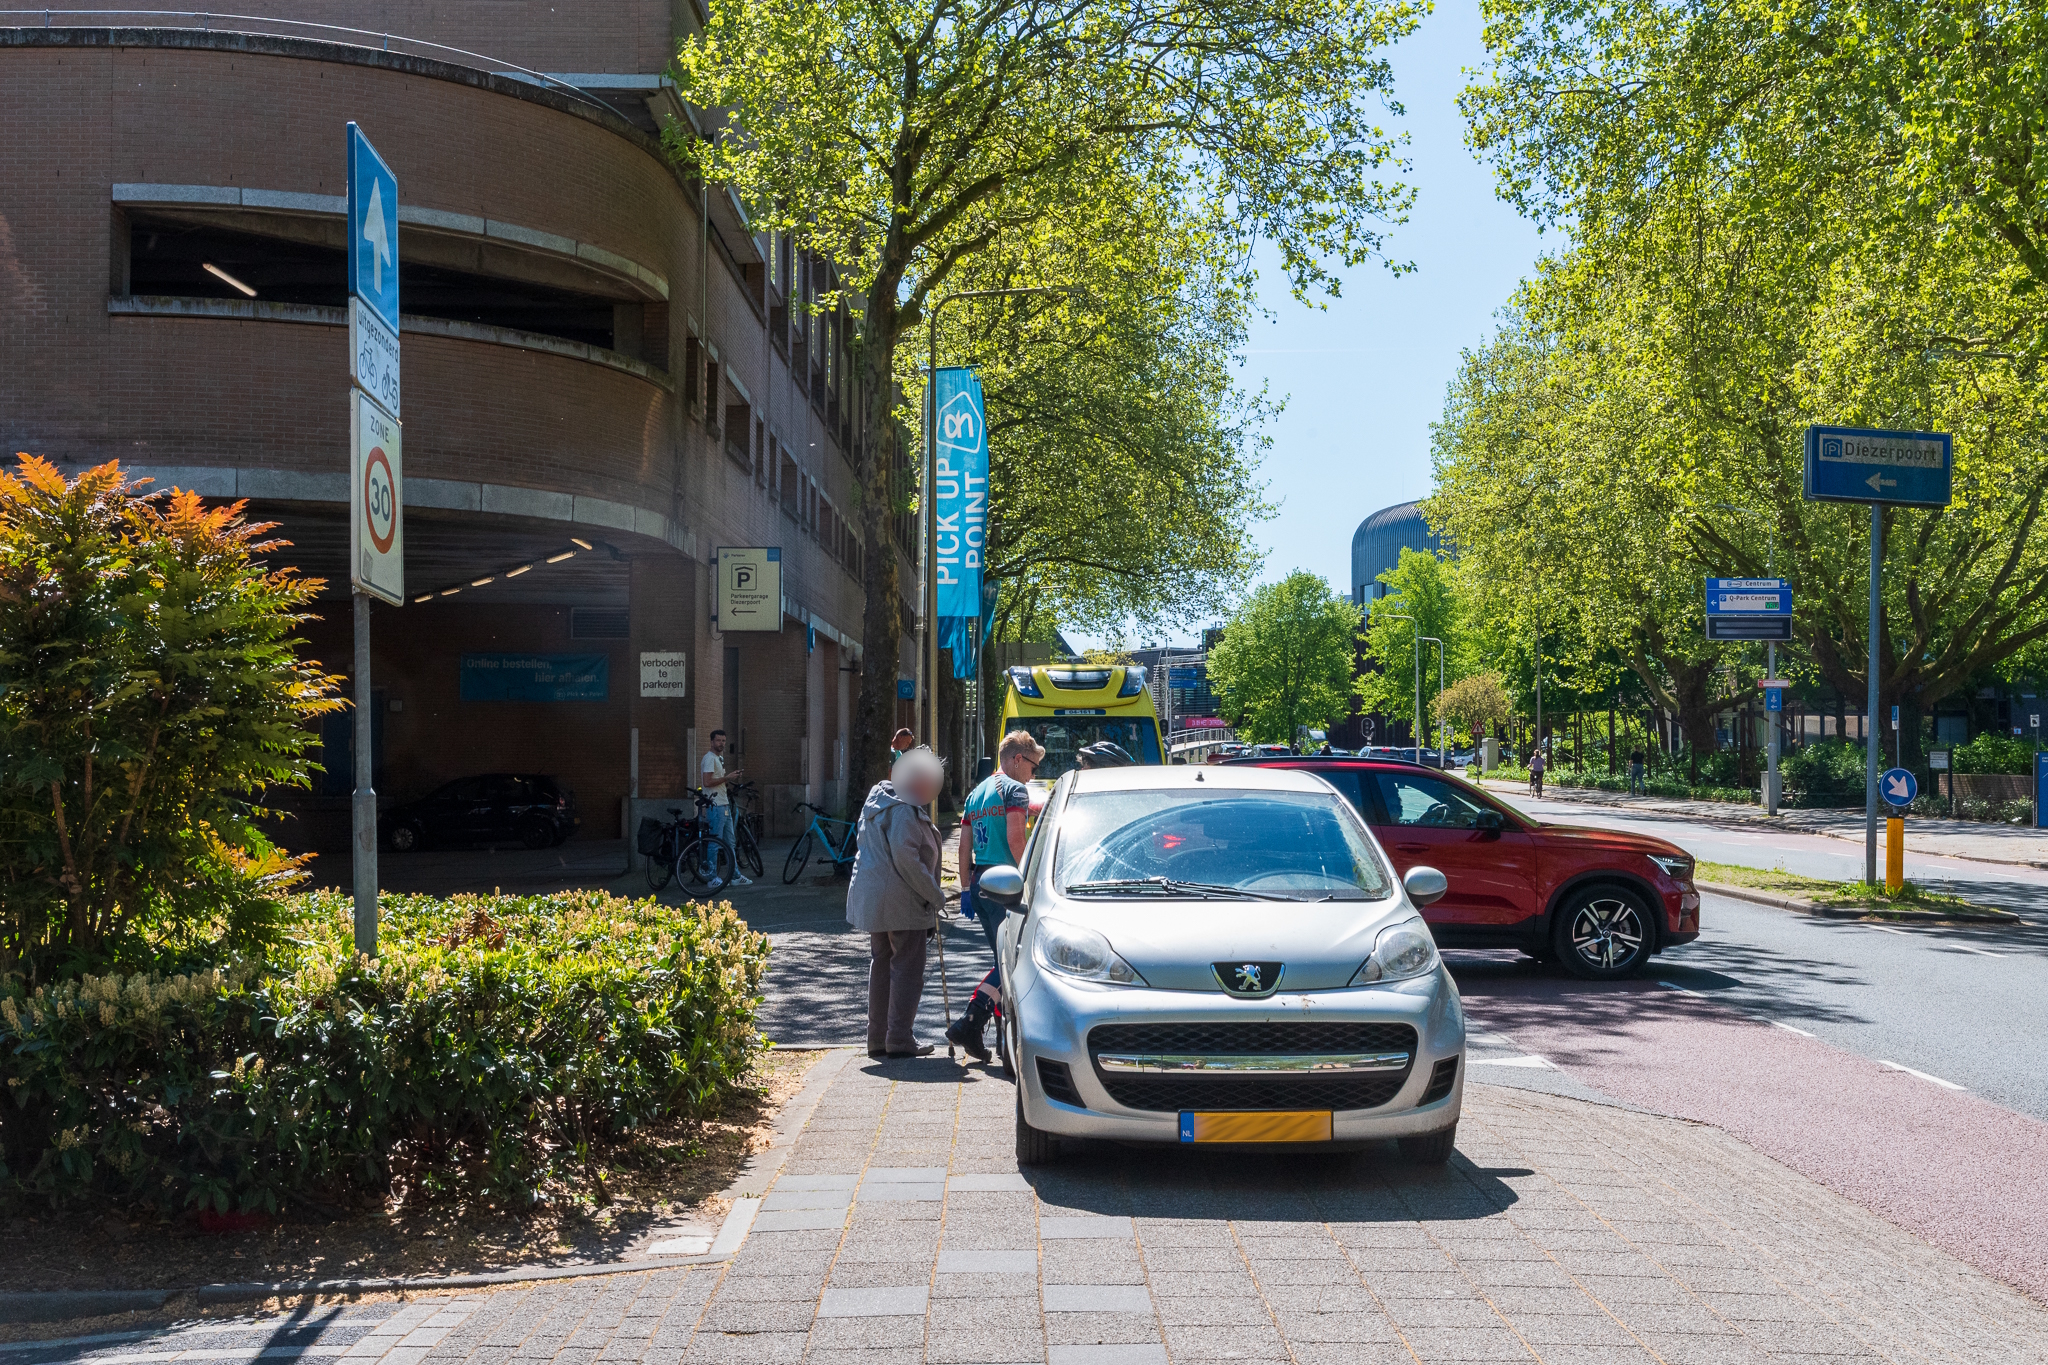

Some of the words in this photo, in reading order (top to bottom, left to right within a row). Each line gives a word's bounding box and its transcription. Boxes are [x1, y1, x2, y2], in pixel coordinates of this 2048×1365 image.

[358, 310, 399, 363] uitgezonderd
[371, 415, 390, 444] ZONE
[1845, 442, 1937, 461] Diezerpoort
[936, 458, 960, 499] UP
[371, 477, 391, 522] 30
[964, 471, 986, 568] POINT
[936, 511, 960, 585] PICK
[737, 571, 751, 588] P
[1765, 602, 1779, 610] VRIJ
[466, 658, 500, 669] Online
[503, 658, 553, 671] bestellen,
[641, 658, 685, 667] verboden
[535, 672, 556, 683] hier
[658, 669, 668, 678] te
[642, 679, 683, 690] parkeren
[1182, 1130, 1193, 1138] NL
